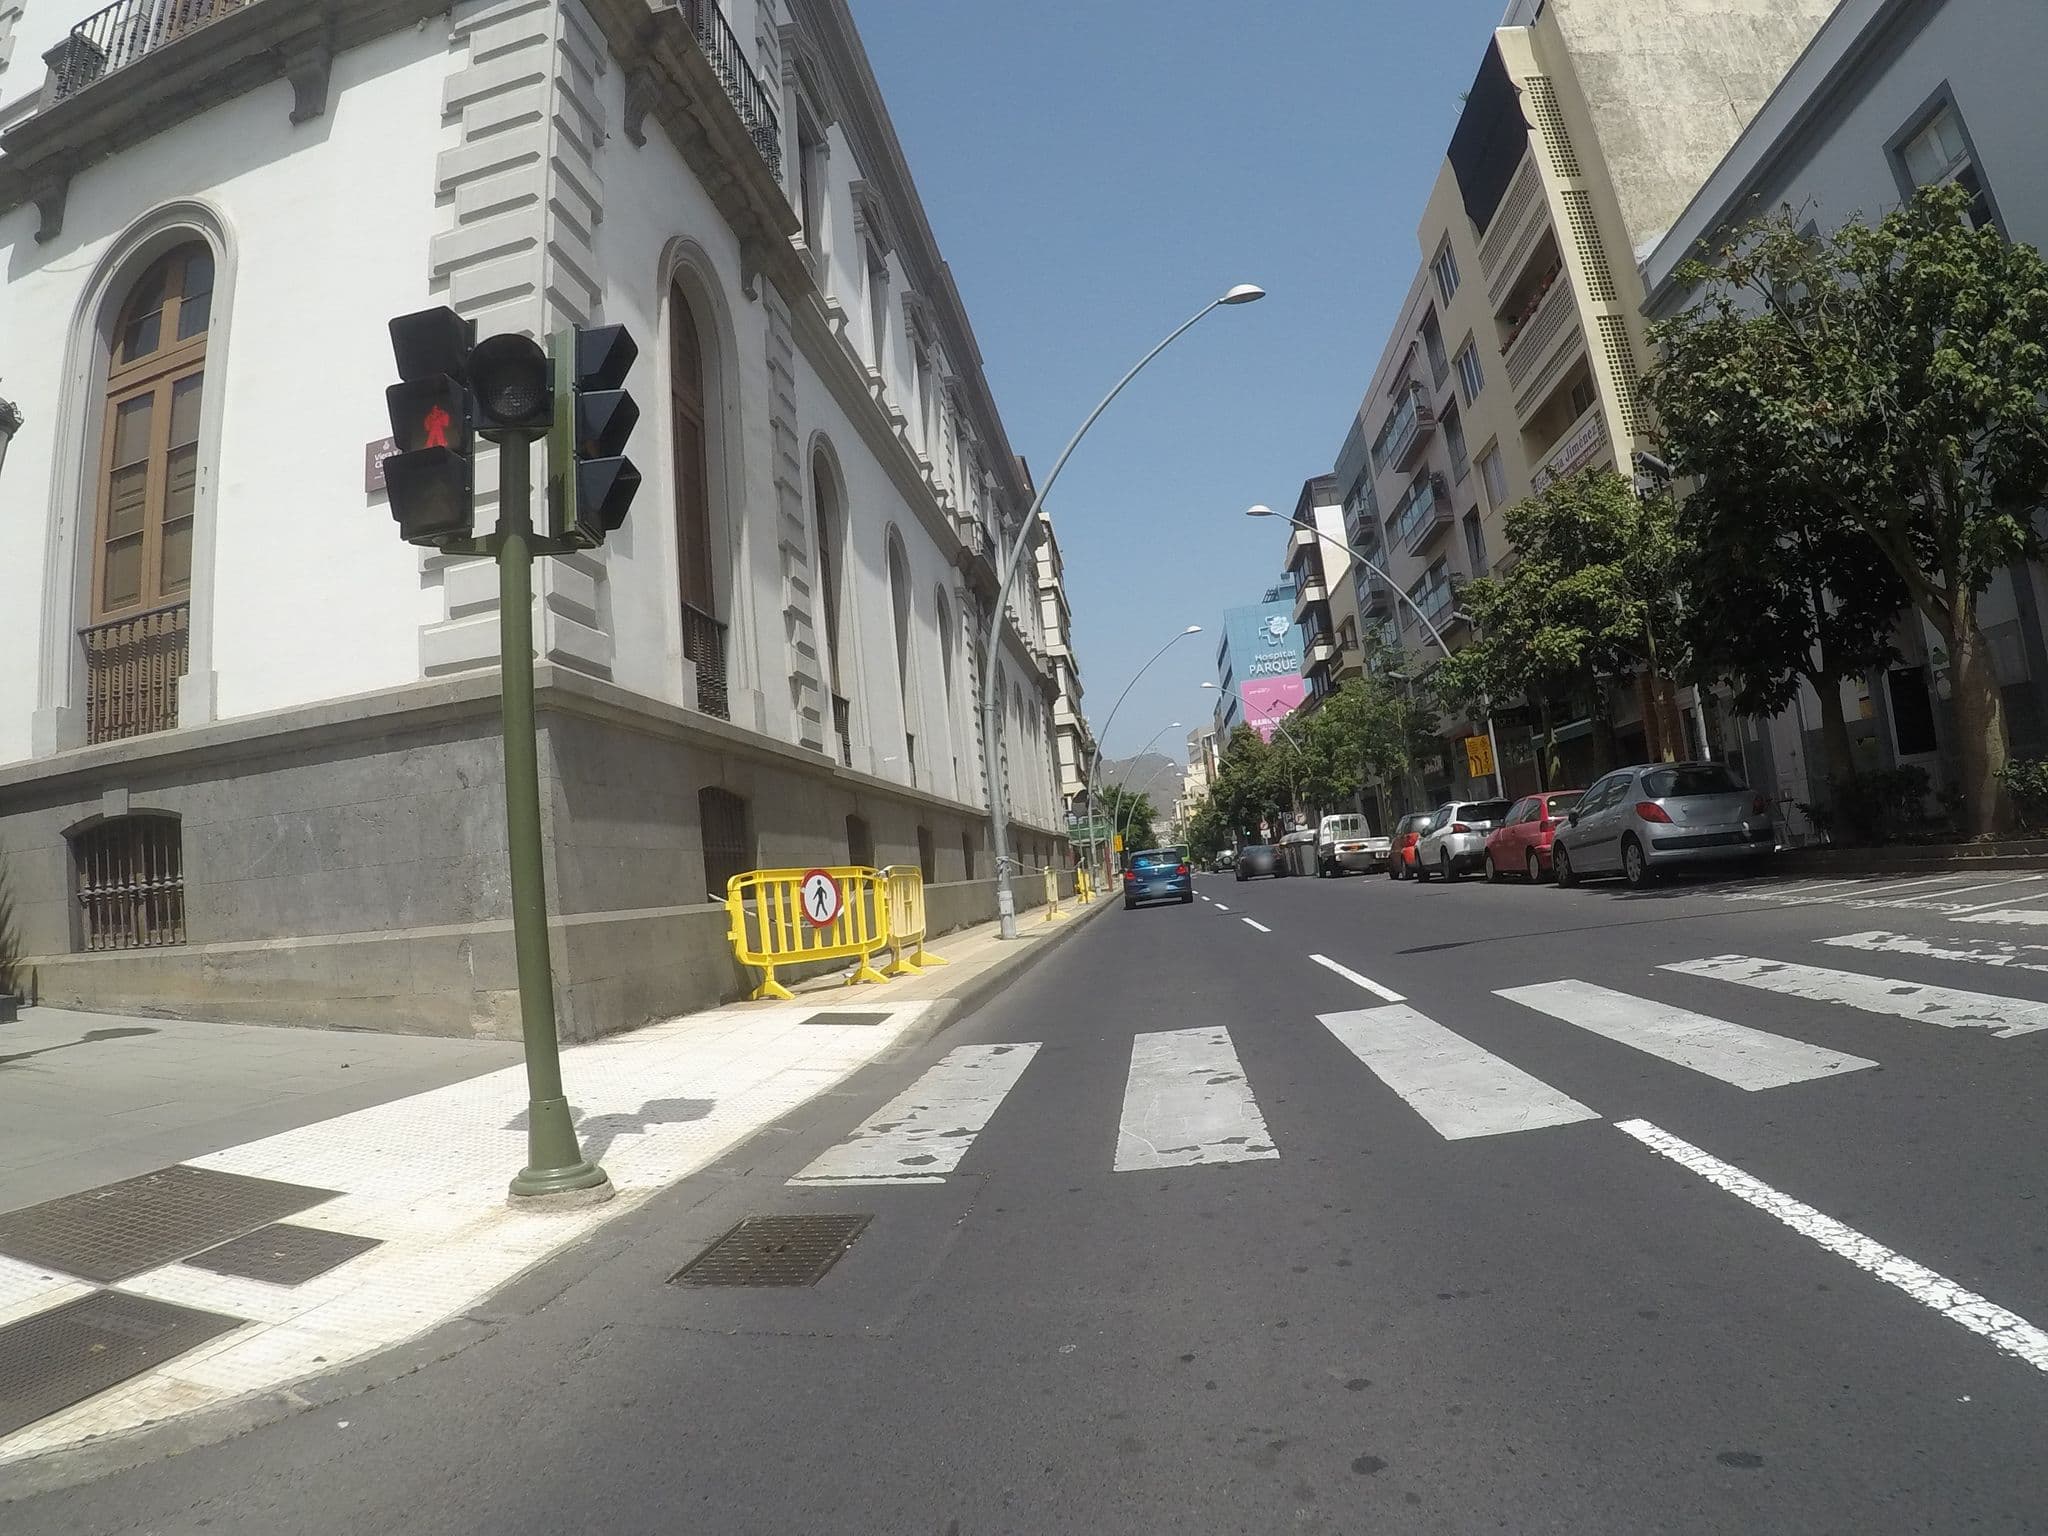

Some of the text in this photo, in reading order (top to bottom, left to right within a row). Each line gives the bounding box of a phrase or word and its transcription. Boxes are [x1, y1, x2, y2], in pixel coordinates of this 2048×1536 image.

[1565, 424, 1597, 461] Jiménez
[1255, 649, 1296, 662] Hospital
[1249, 659, 1298, 674] PARQUE
